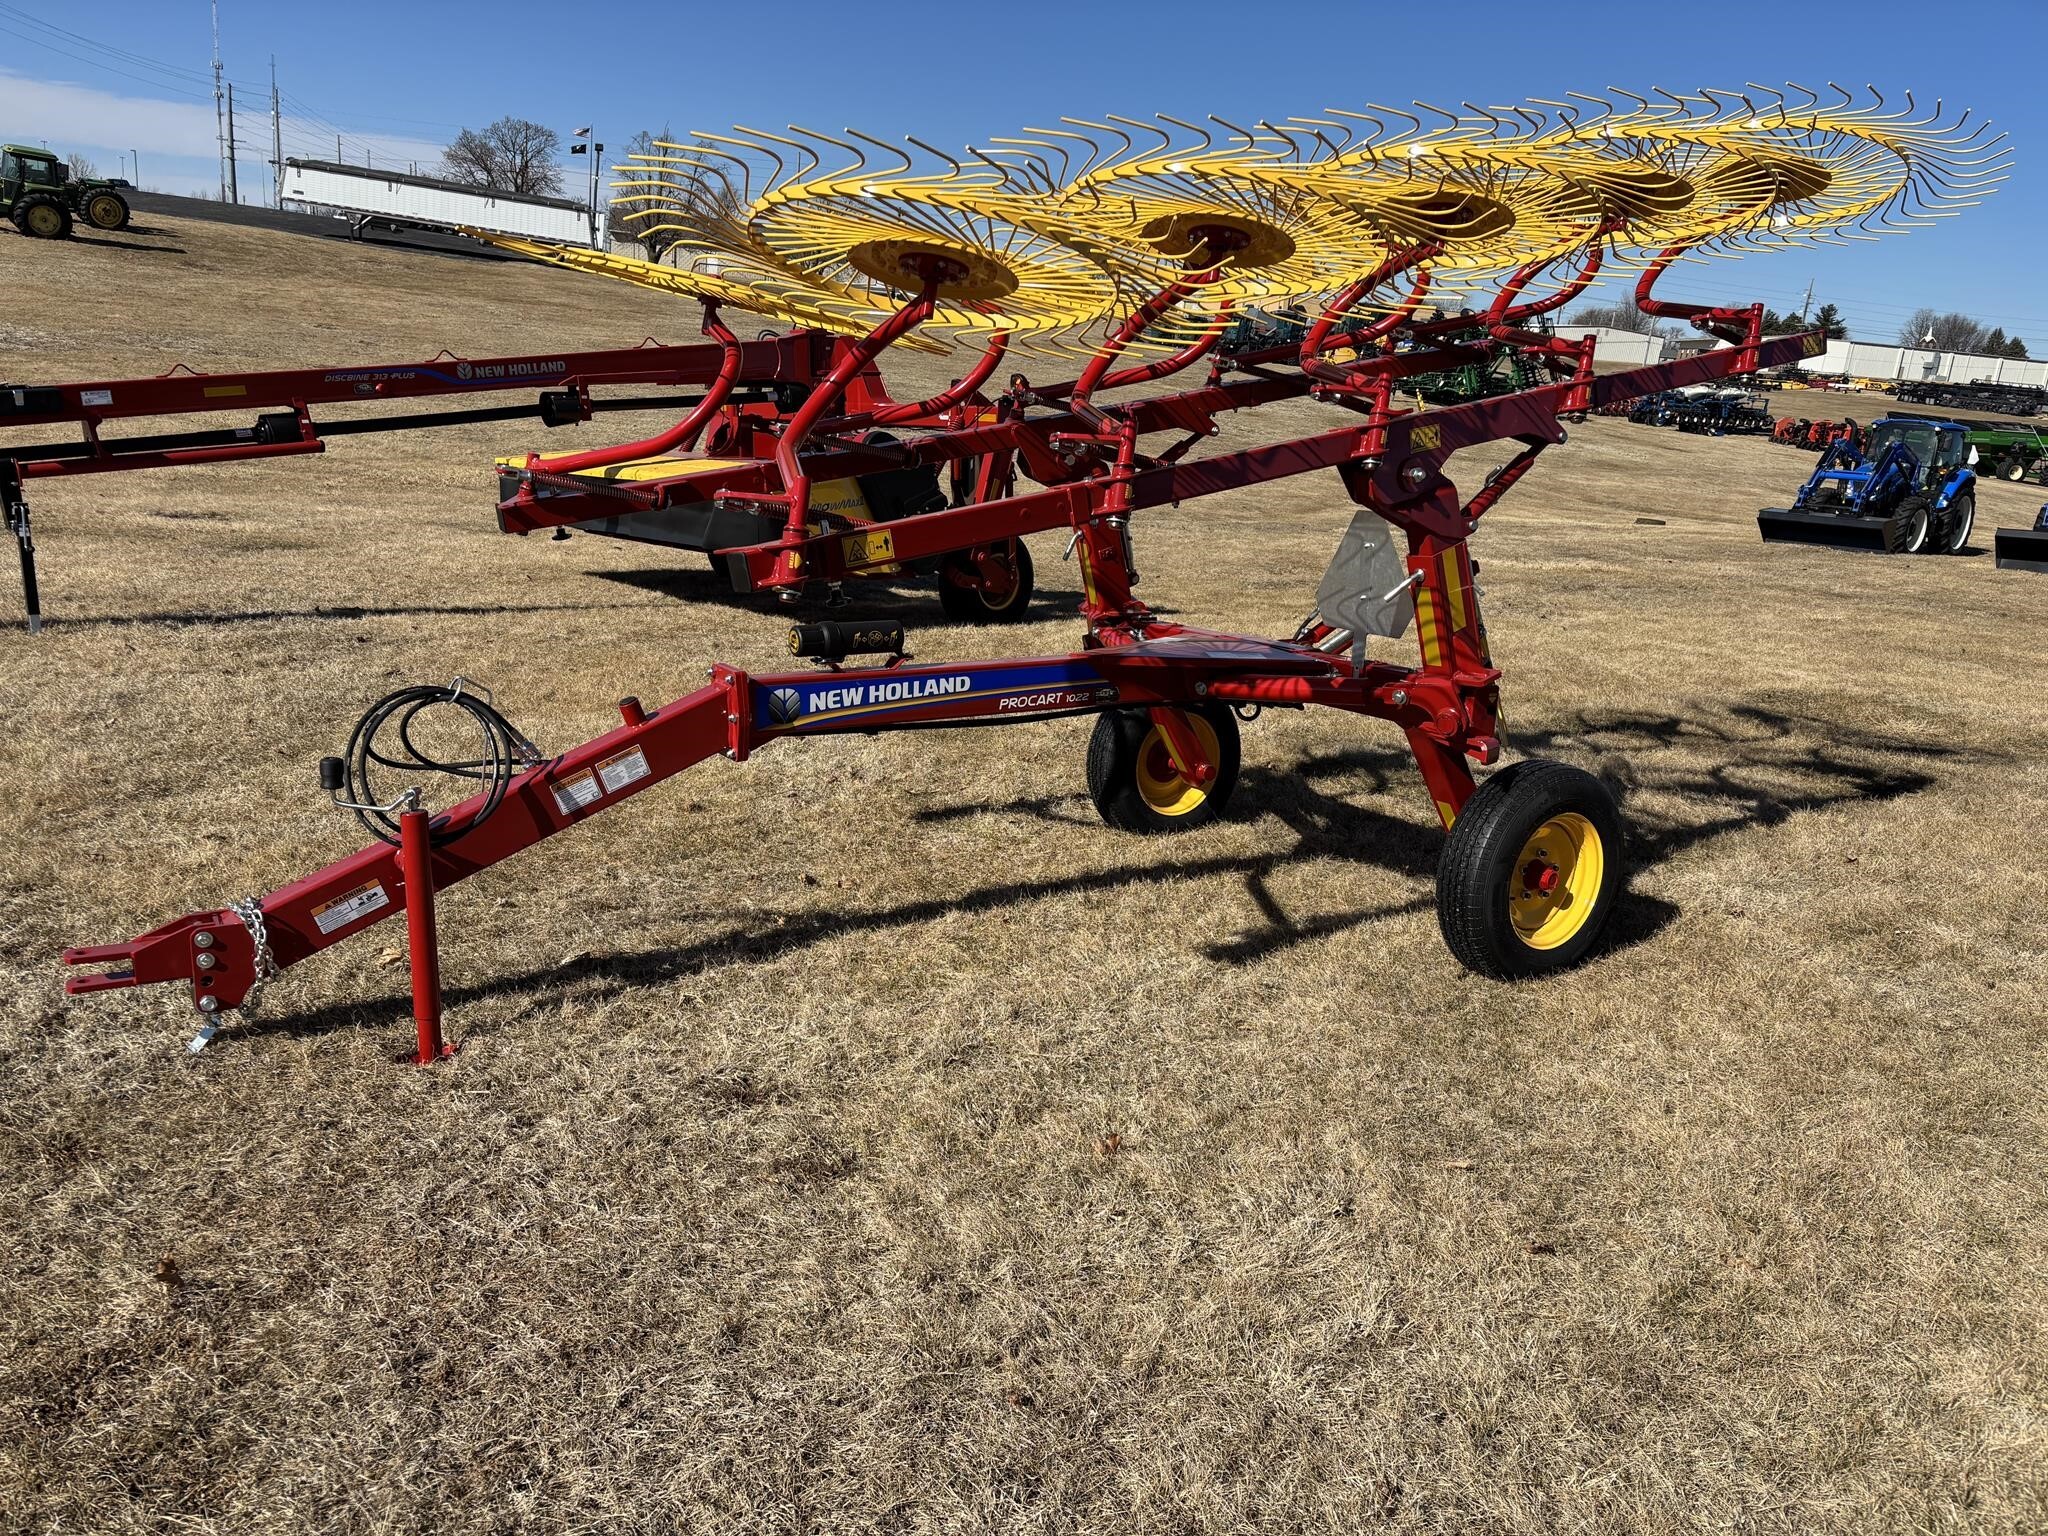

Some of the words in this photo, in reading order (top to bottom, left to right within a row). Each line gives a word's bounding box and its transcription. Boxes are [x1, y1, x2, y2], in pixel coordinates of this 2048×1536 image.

[324, 373, 370, 382] DISCBINE
[372, 373, 388, 381] 313
[475, 364, 504, 378] NEW
[508, 360, 566, 376] HOLLAND
[809, 686, 864, 713] NEW
[869, 676, 971, 704] HOLLAND
[998, 692, 1063, 711] PROCART
[1066, 692, 1089, 703] 1022
[331, 885, 368, 906] WARNING
